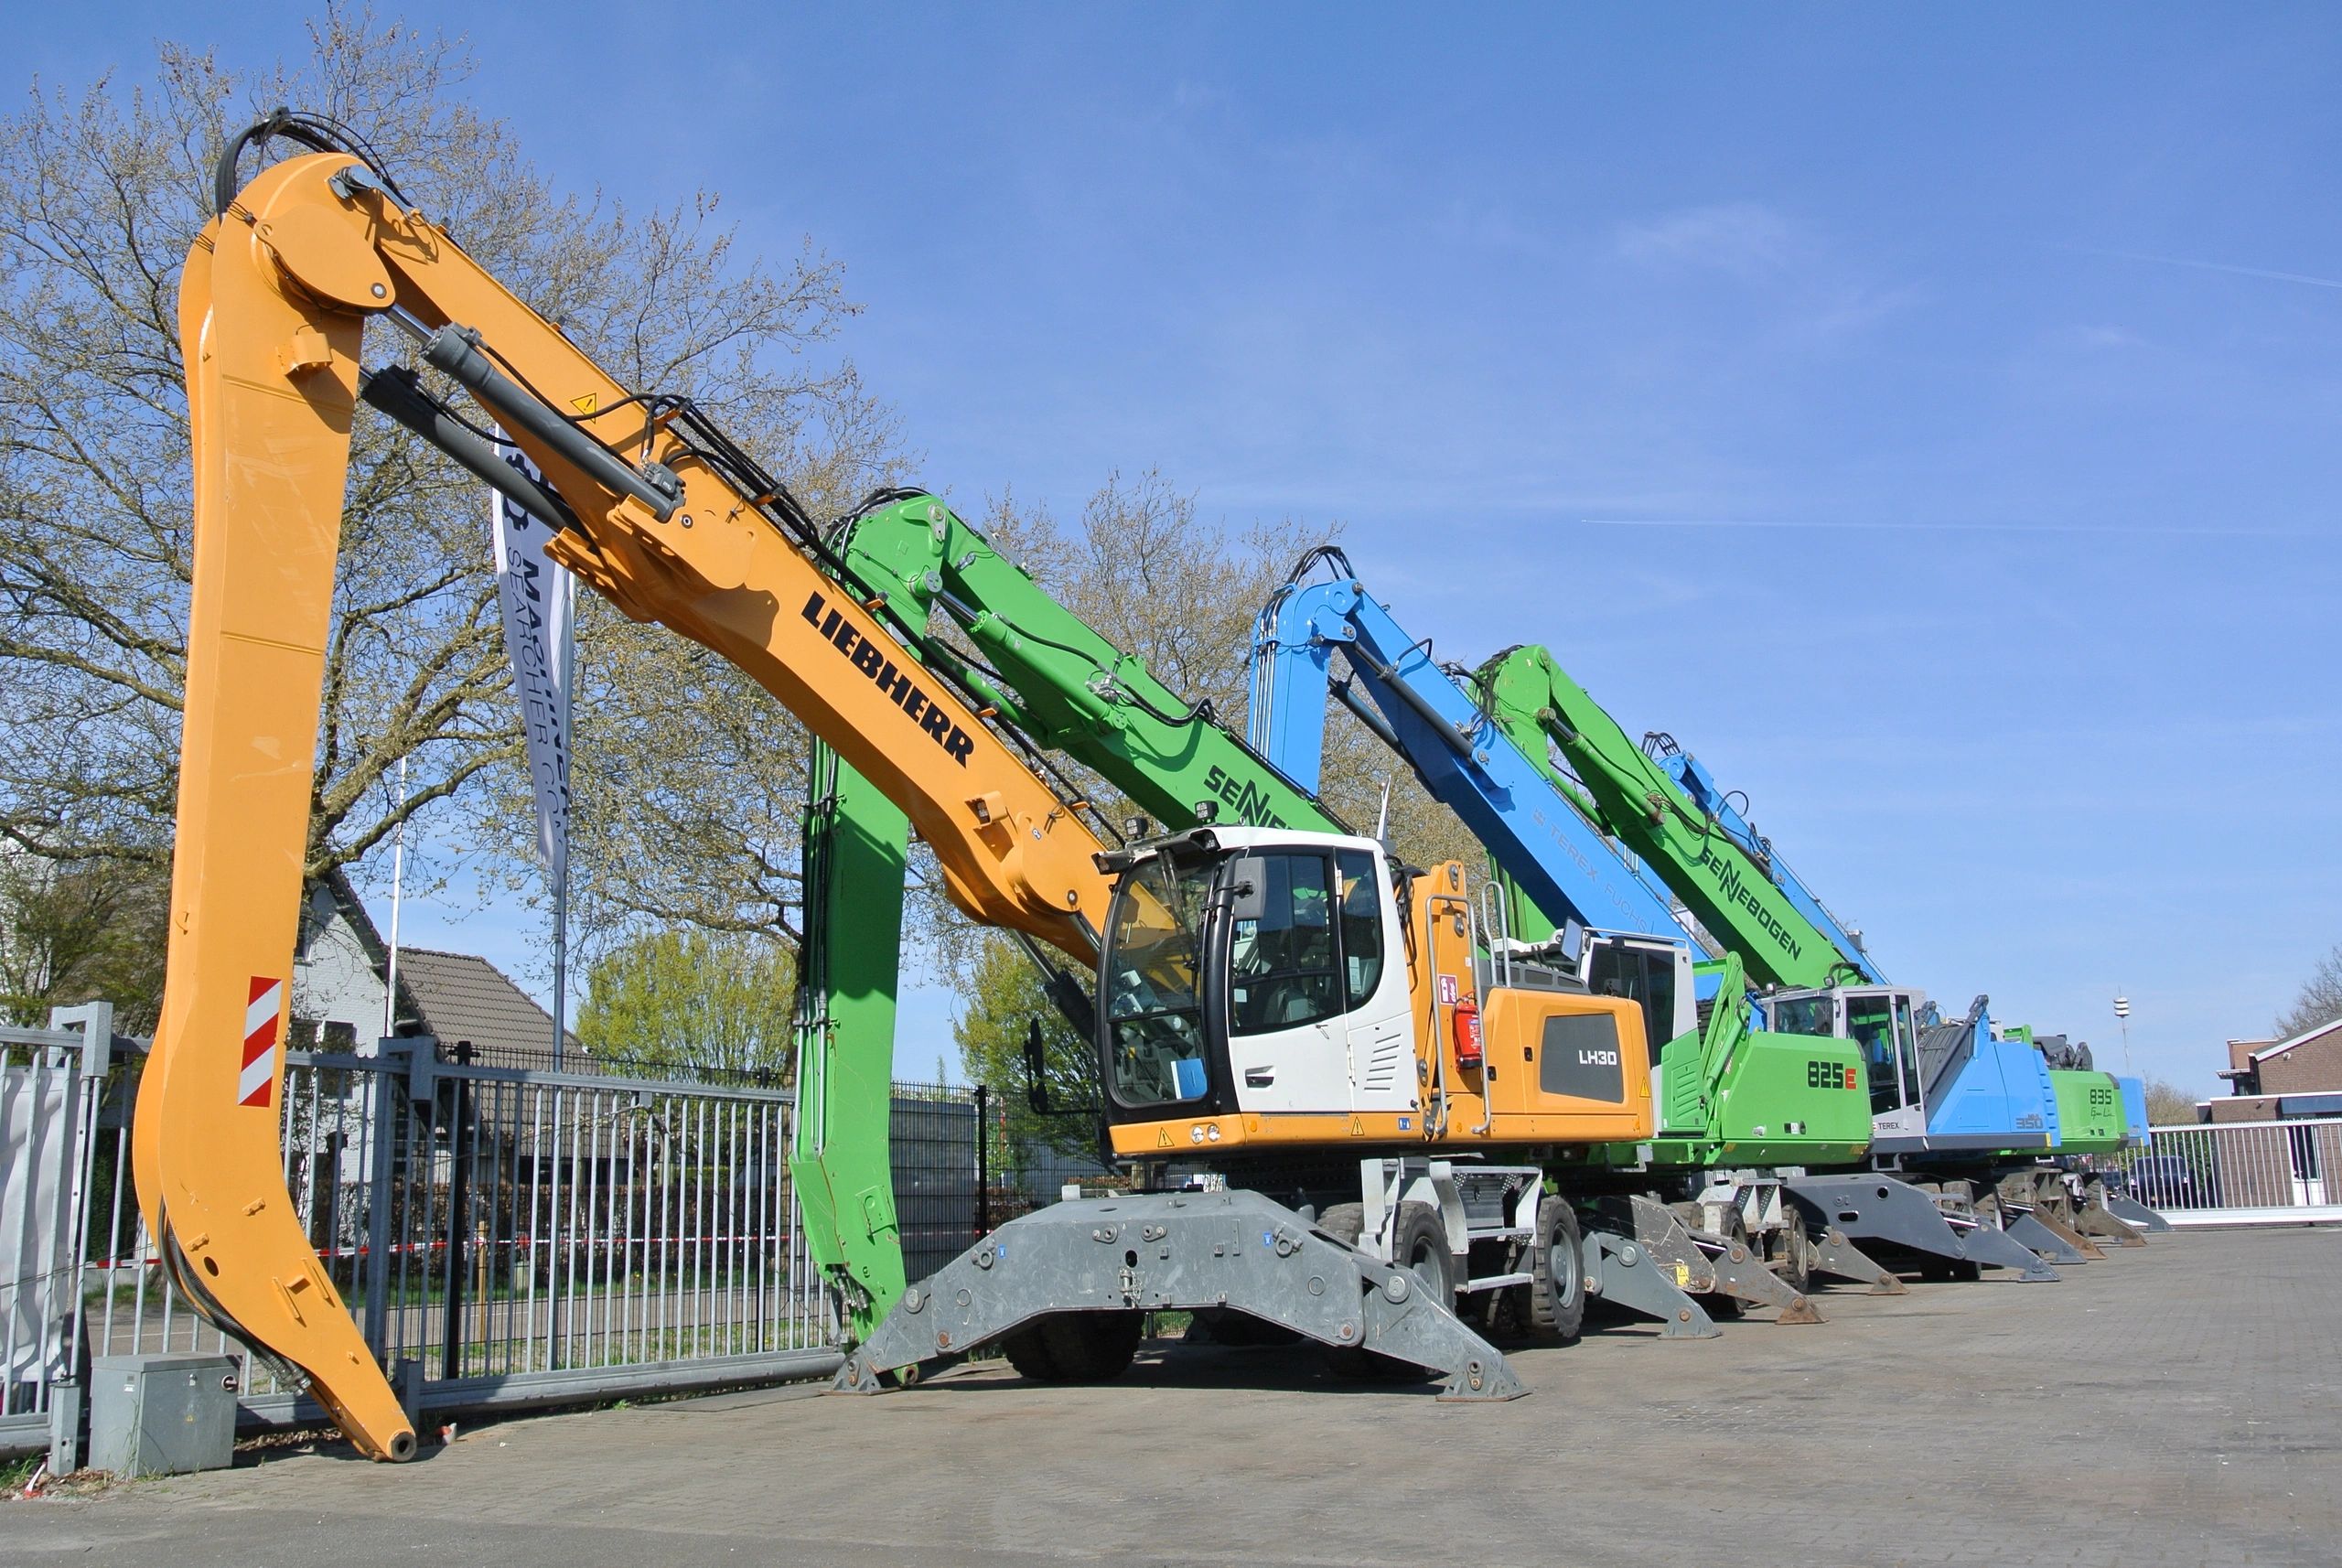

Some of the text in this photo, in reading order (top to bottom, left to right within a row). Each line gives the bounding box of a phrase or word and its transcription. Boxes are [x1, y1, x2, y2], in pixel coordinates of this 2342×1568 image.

[507, 545, 549, 745] SEARCHER
[800, 591, 974, 768] LIEBHERR
[1550, 823, 1648, 933] TEREX FUCHS
[1700, 846, 1802, 961] SENNEBOGEN
[1578, 1049, 1617, 1066] LH30
[2090, 1089, 2112, 1105] 835
[1878, 1122, 1900, 1130] TEREX
